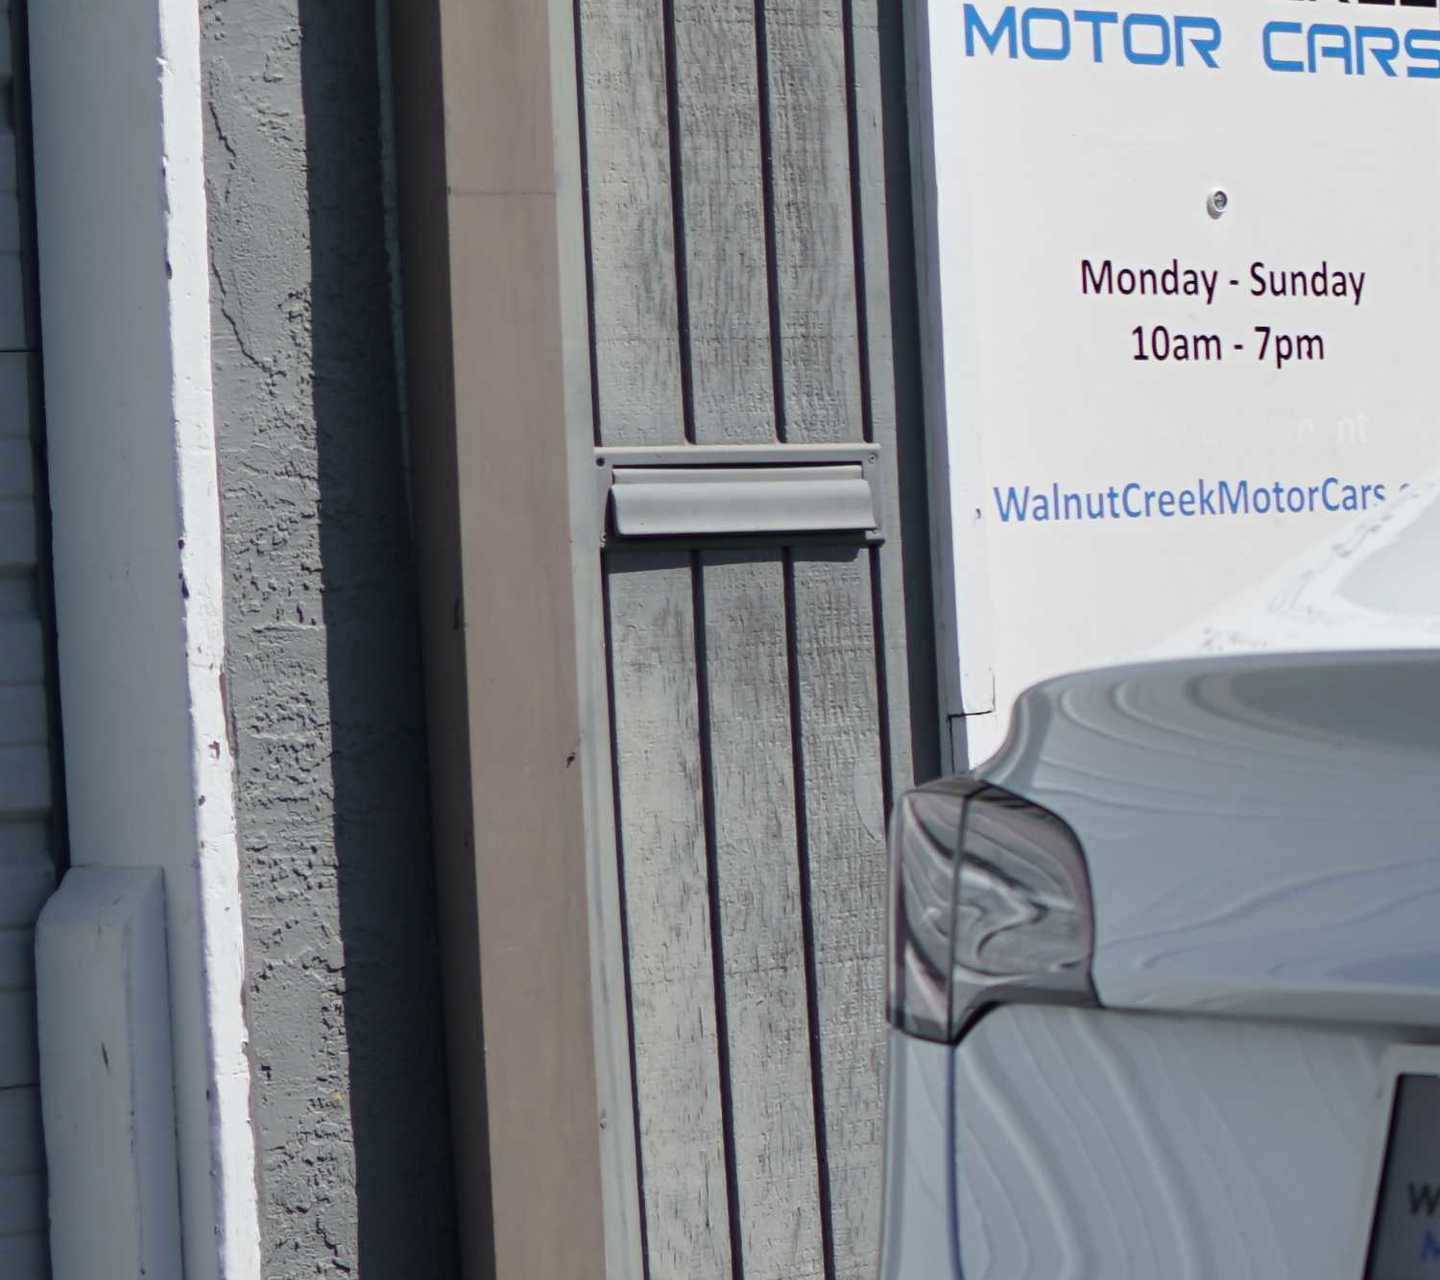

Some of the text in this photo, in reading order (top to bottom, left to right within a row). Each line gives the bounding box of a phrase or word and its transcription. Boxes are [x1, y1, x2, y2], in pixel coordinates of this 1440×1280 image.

[963, 3, 1222, 69] MOTOR
[1080, 259, 1219, 305] Monday
[1249, 261, 1367, 306] Sunday
[1132, 326, 1224, 362] 10am
[1254, 326, 1326, 369] 7pm
